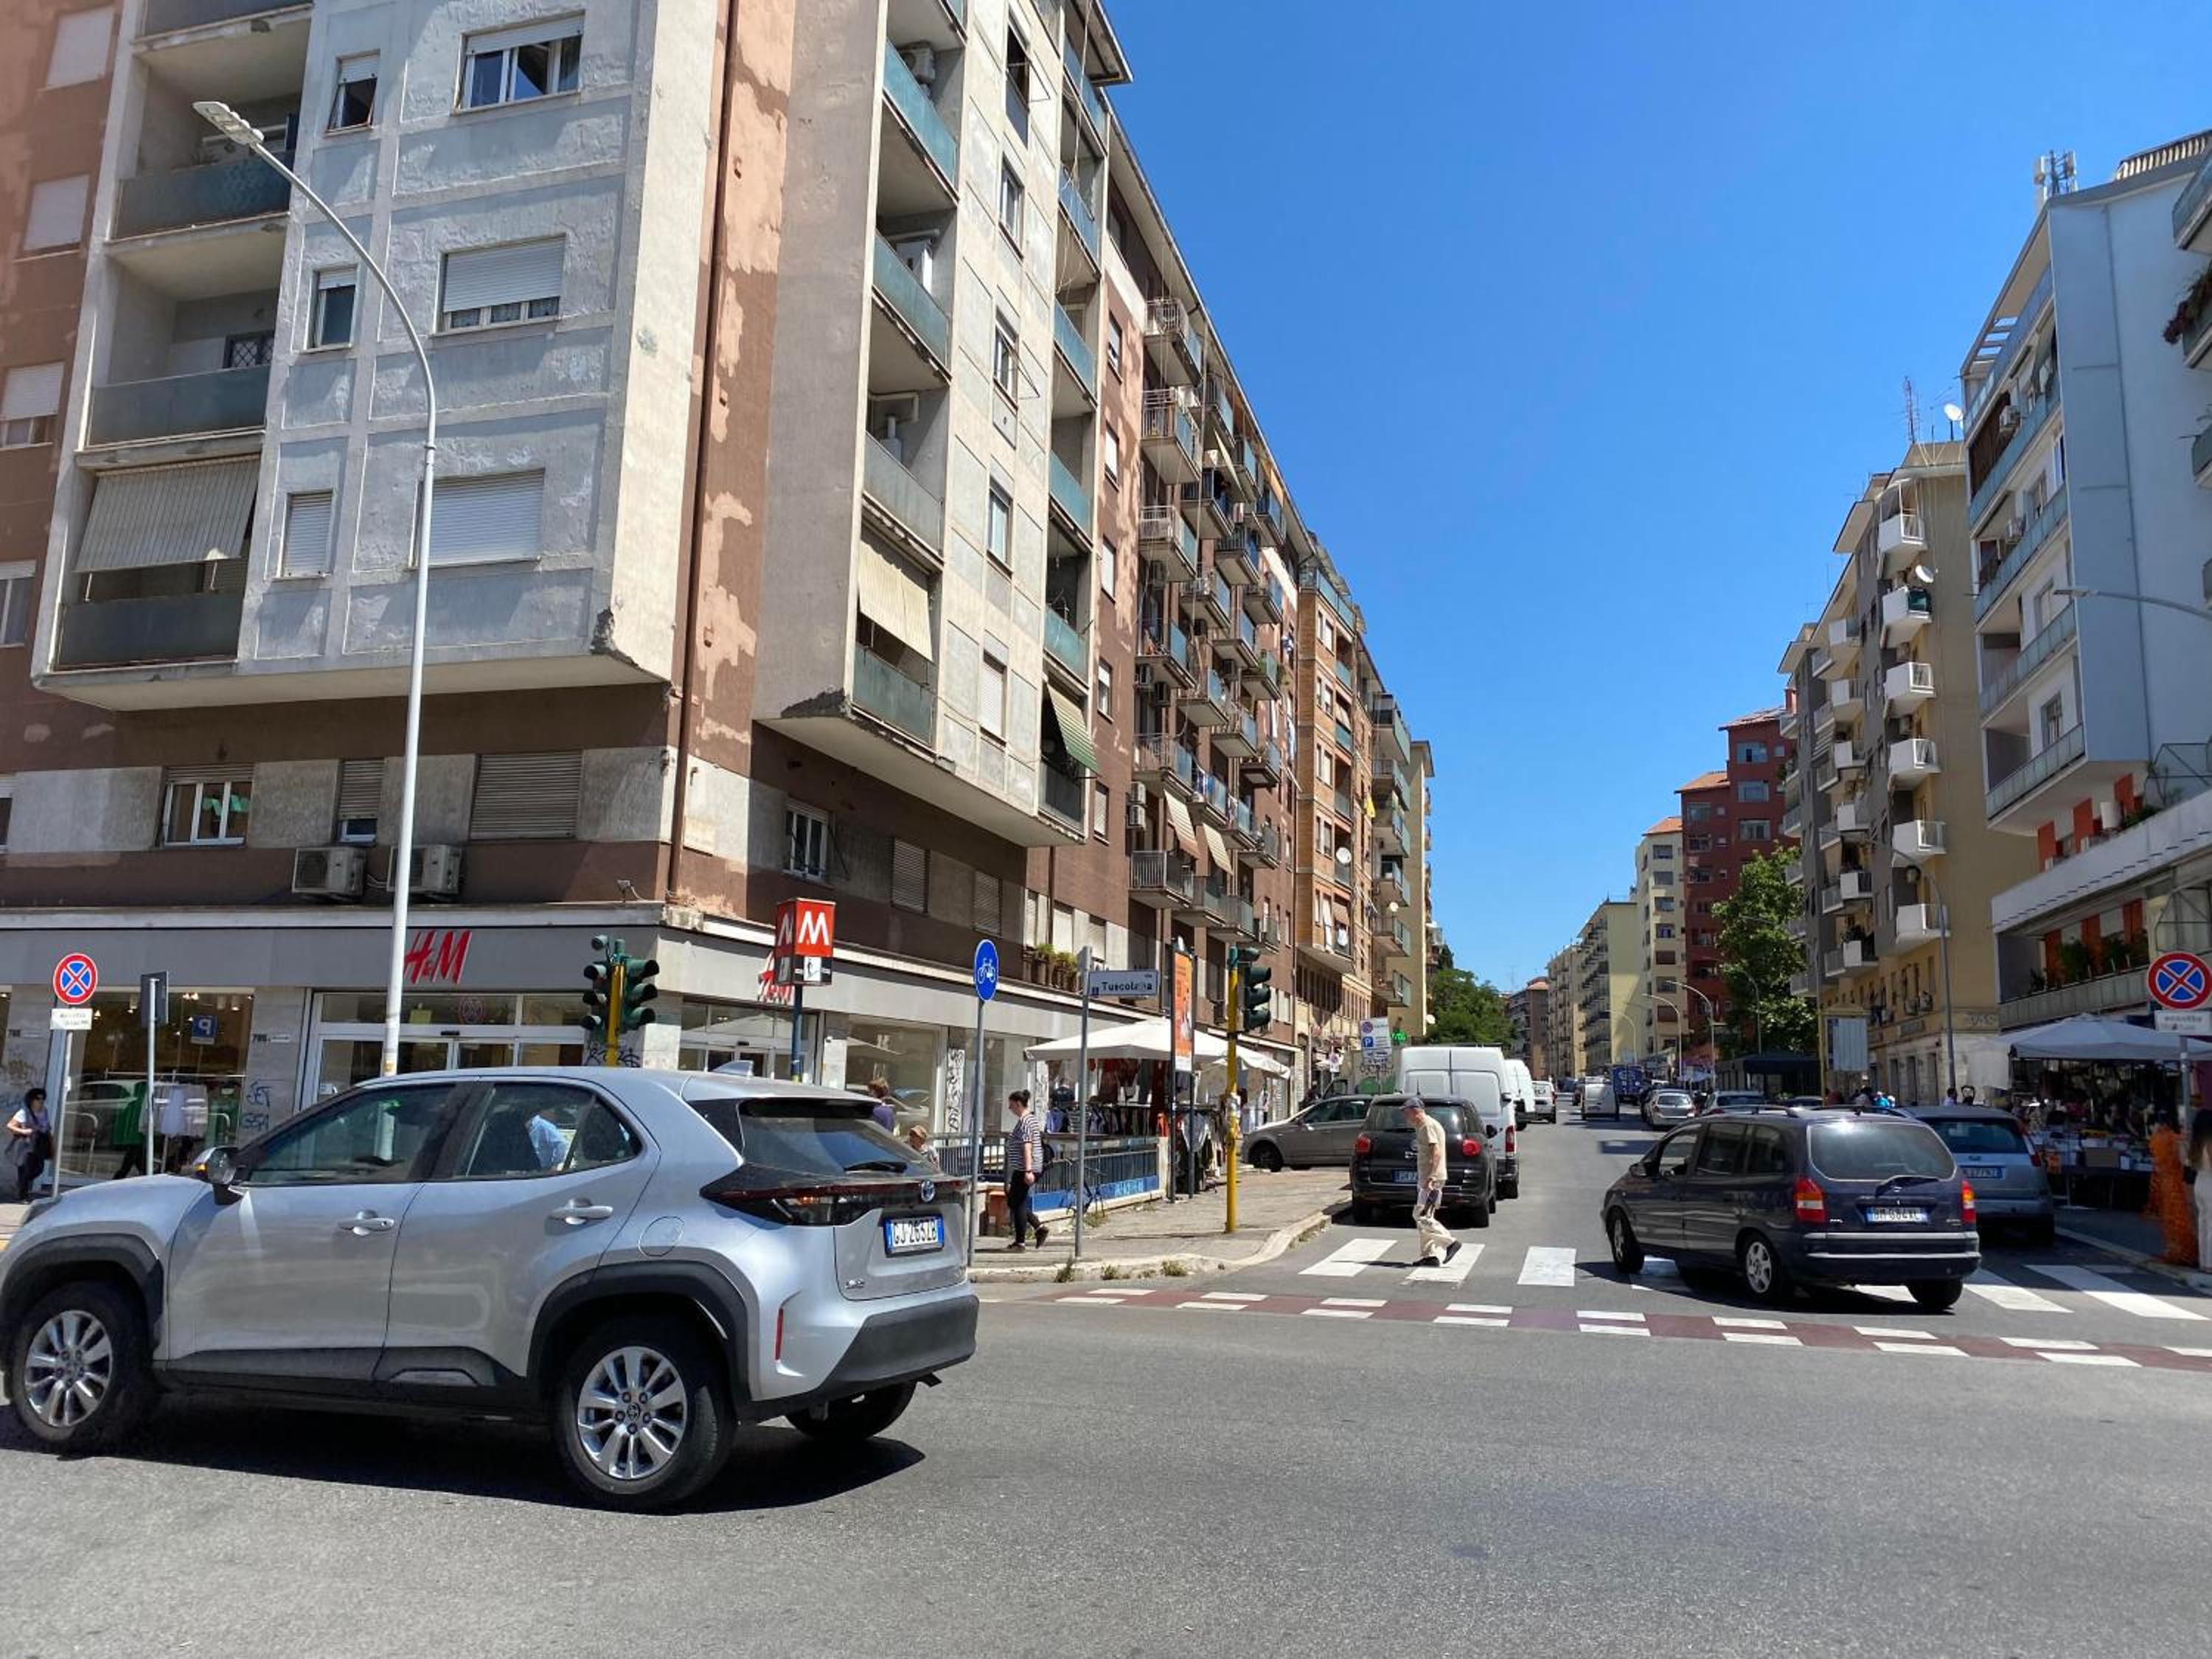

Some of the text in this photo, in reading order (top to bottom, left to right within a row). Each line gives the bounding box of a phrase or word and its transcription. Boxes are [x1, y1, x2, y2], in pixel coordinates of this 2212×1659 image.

[778, 914, 794, 946] M
[798, 911, 830, 945] M
[403, 931, 472, 984] H&M
[1101, 981, 1152, 990] Tuscola
